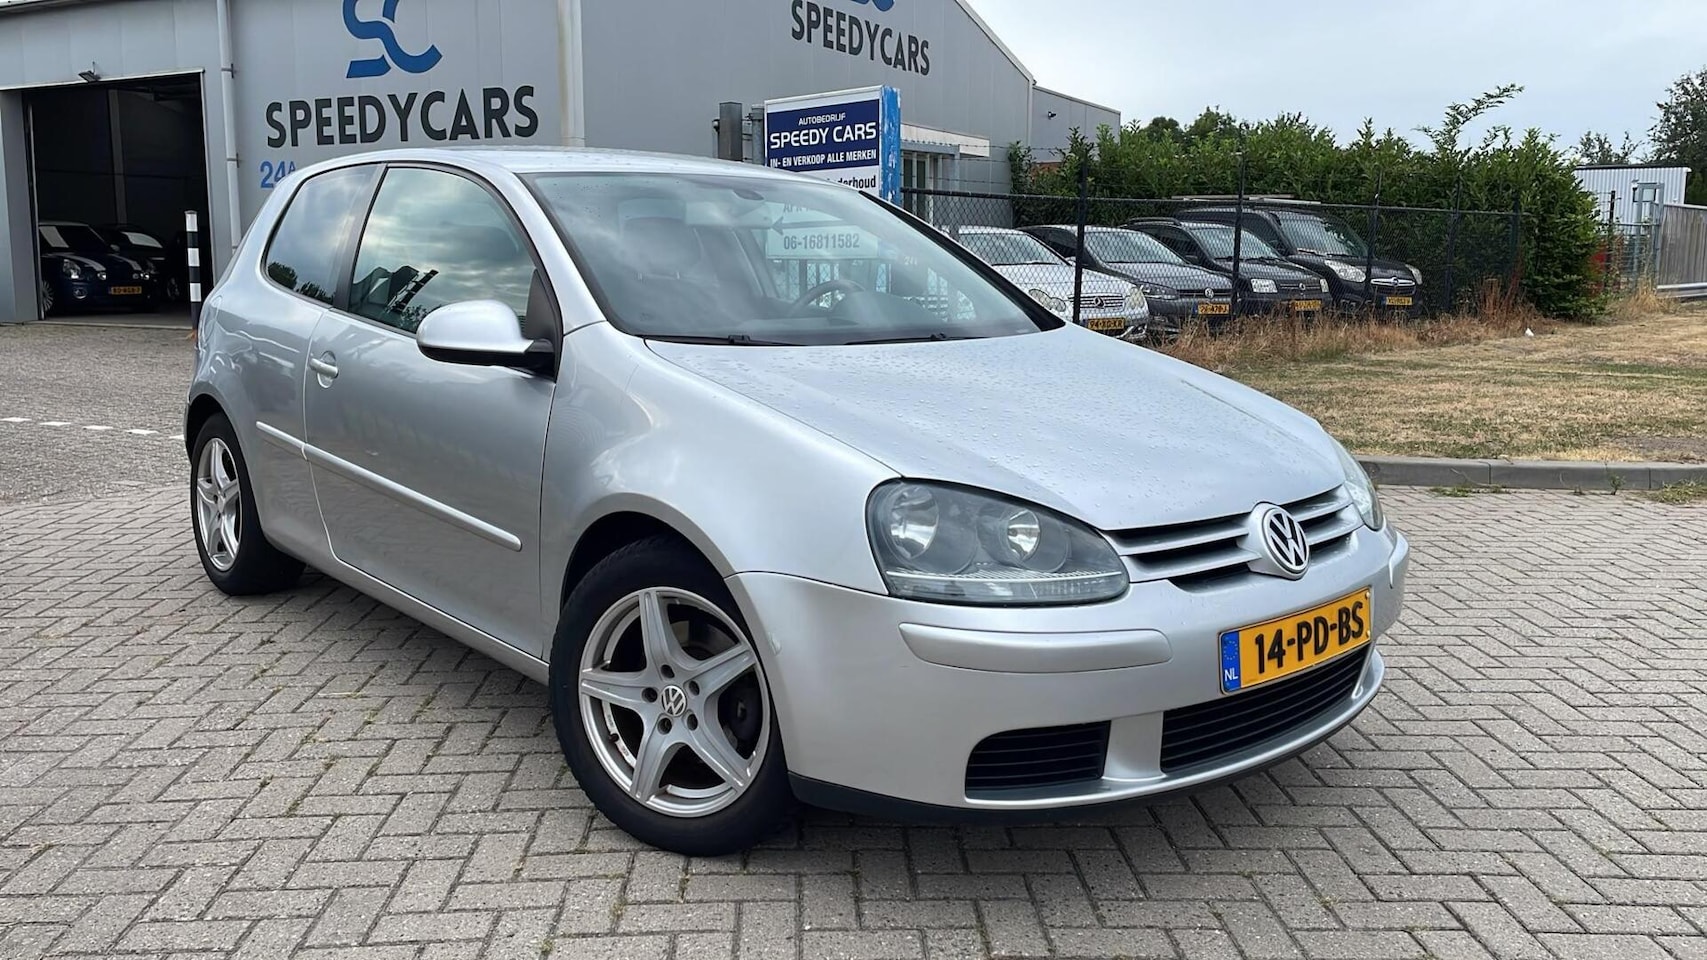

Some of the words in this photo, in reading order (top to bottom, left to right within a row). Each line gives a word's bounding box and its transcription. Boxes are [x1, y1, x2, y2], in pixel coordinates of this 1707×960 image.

[790, 0, 930, 76] SPEEDYCARS
[265, 85, 539, 148] SPEEDYCARS
[798, 112, 846, 126] AUTOBEDRIJF
[769, 127, 829, 149] SPEEDY
[832, 122, 877, 143] CARS
[769, 158, 781, 168] IN-
[782, 156, 792, 167] EN
[793, 153, 825, 166] VERKOOP
[826, 151, 844, 163] ALLE
[846, 149, 877, 161] MERKEN
[783, 233, 860, 250] 06-16811582
[1254, 601, 1364, 675] 14-PD-BS
[1224, 669, 1239, 682] NL
